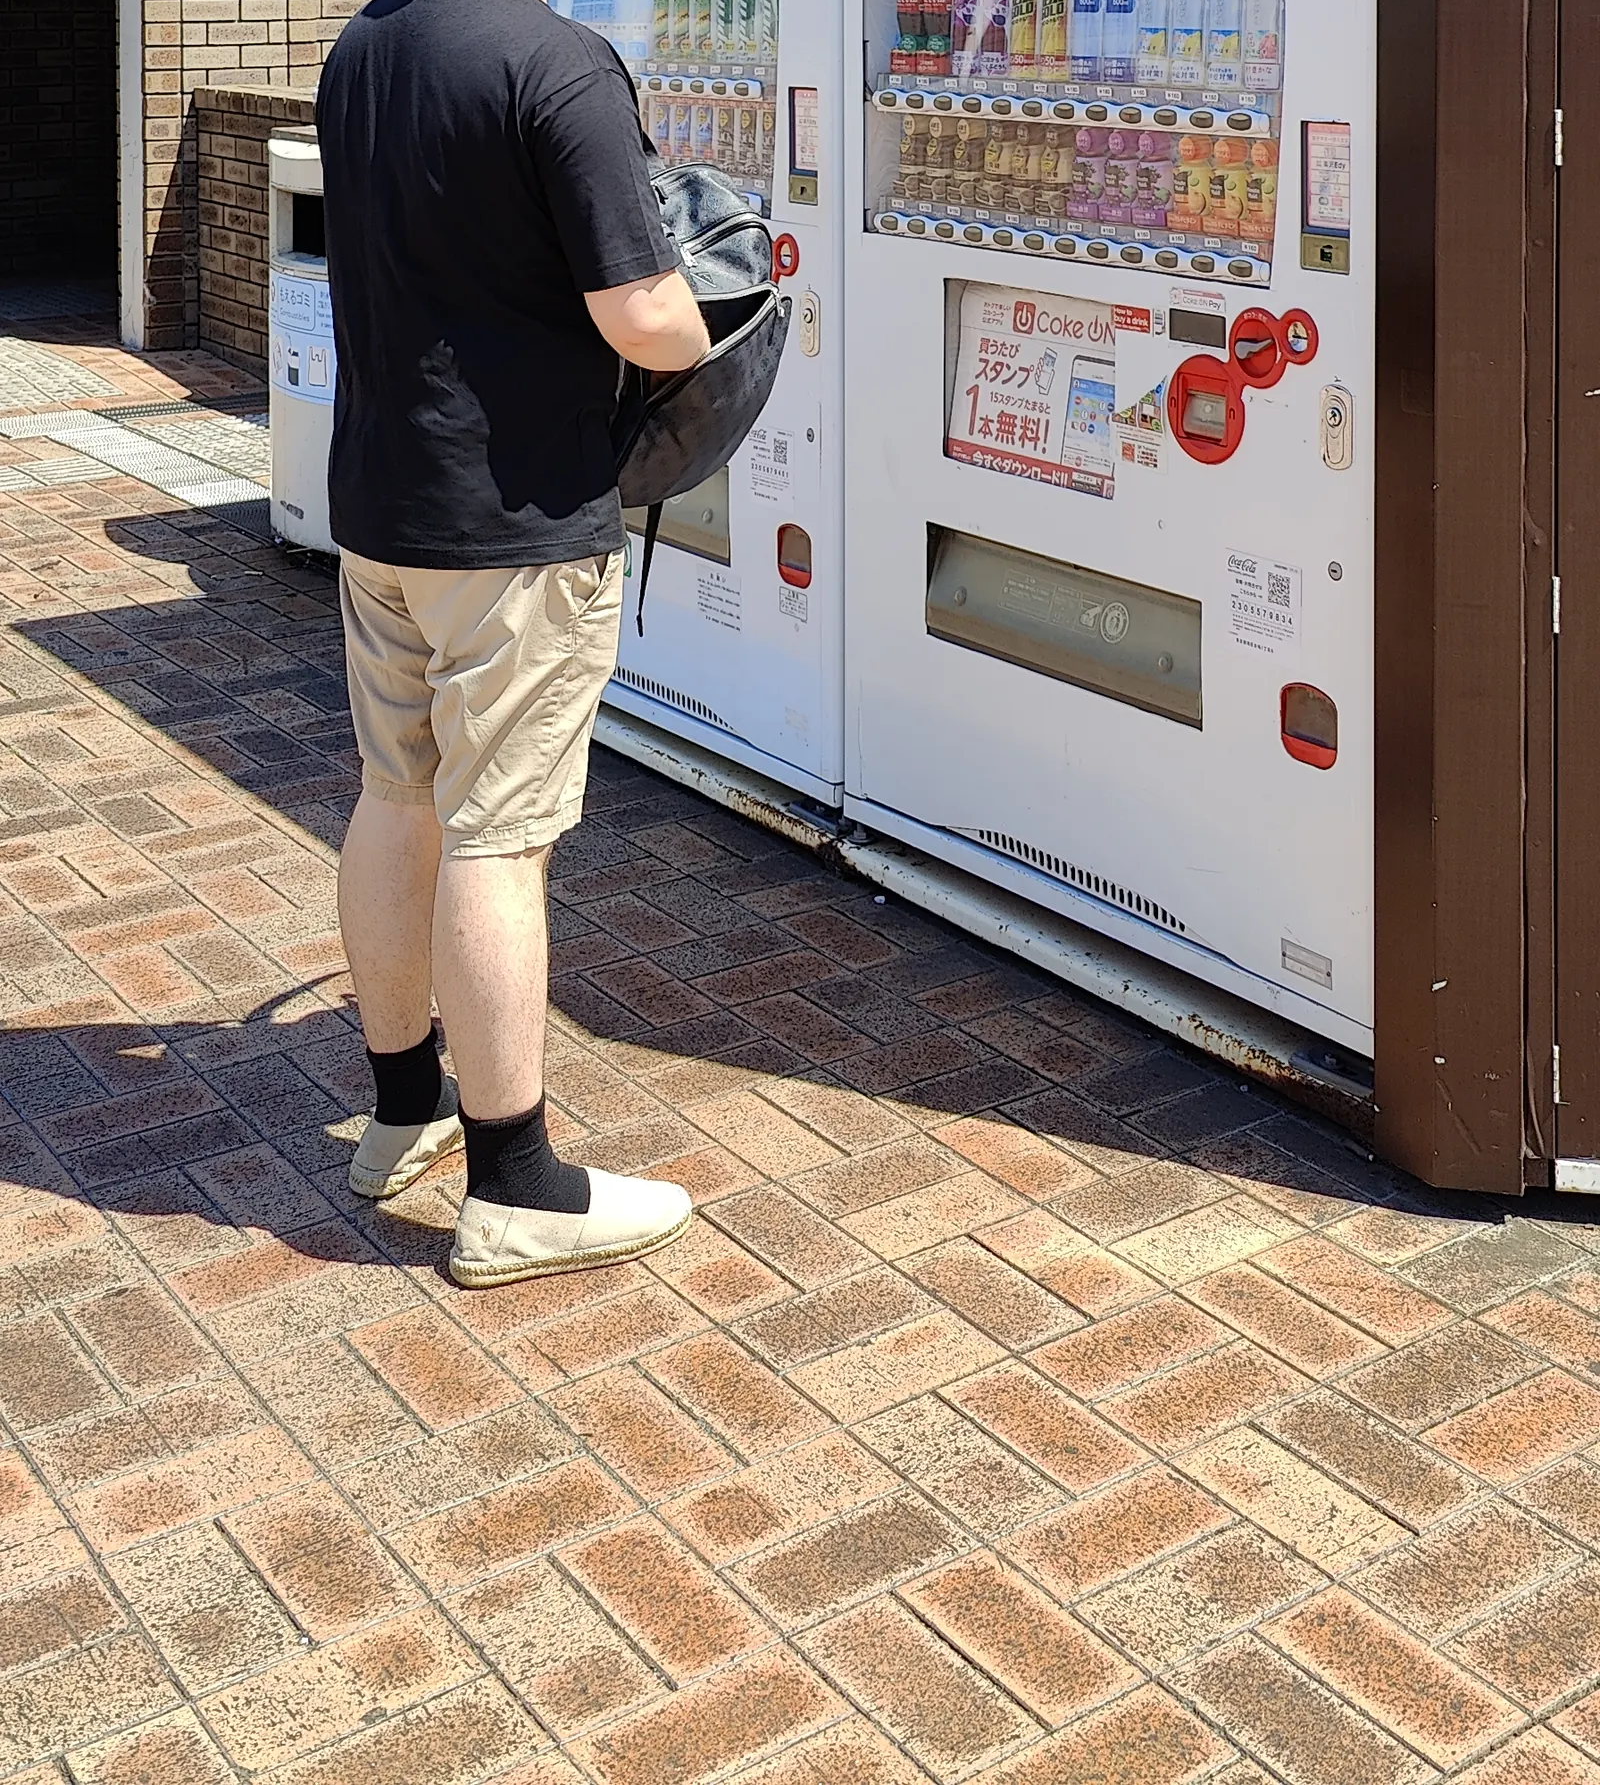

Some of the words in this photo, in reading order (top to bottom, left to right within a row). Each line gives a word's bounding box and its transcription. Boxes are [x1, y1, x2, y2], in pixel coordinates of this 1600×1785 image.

[1208, 300, 1222, 310] Pay
[1037, 310, 1084, 340] Coke
[1088, 314, 1116, 346] ON
[1114, 315, 1126, 324] buy
[1132, 317, 1149, 326] drink
[978, 337, 1021, 359] 買うたび
[974, 358, 1035, 389] スタンプ
[990, 390, 1052, 415] 15スタンプたまると
[966, 384, 1050, 454] 1本無料!
